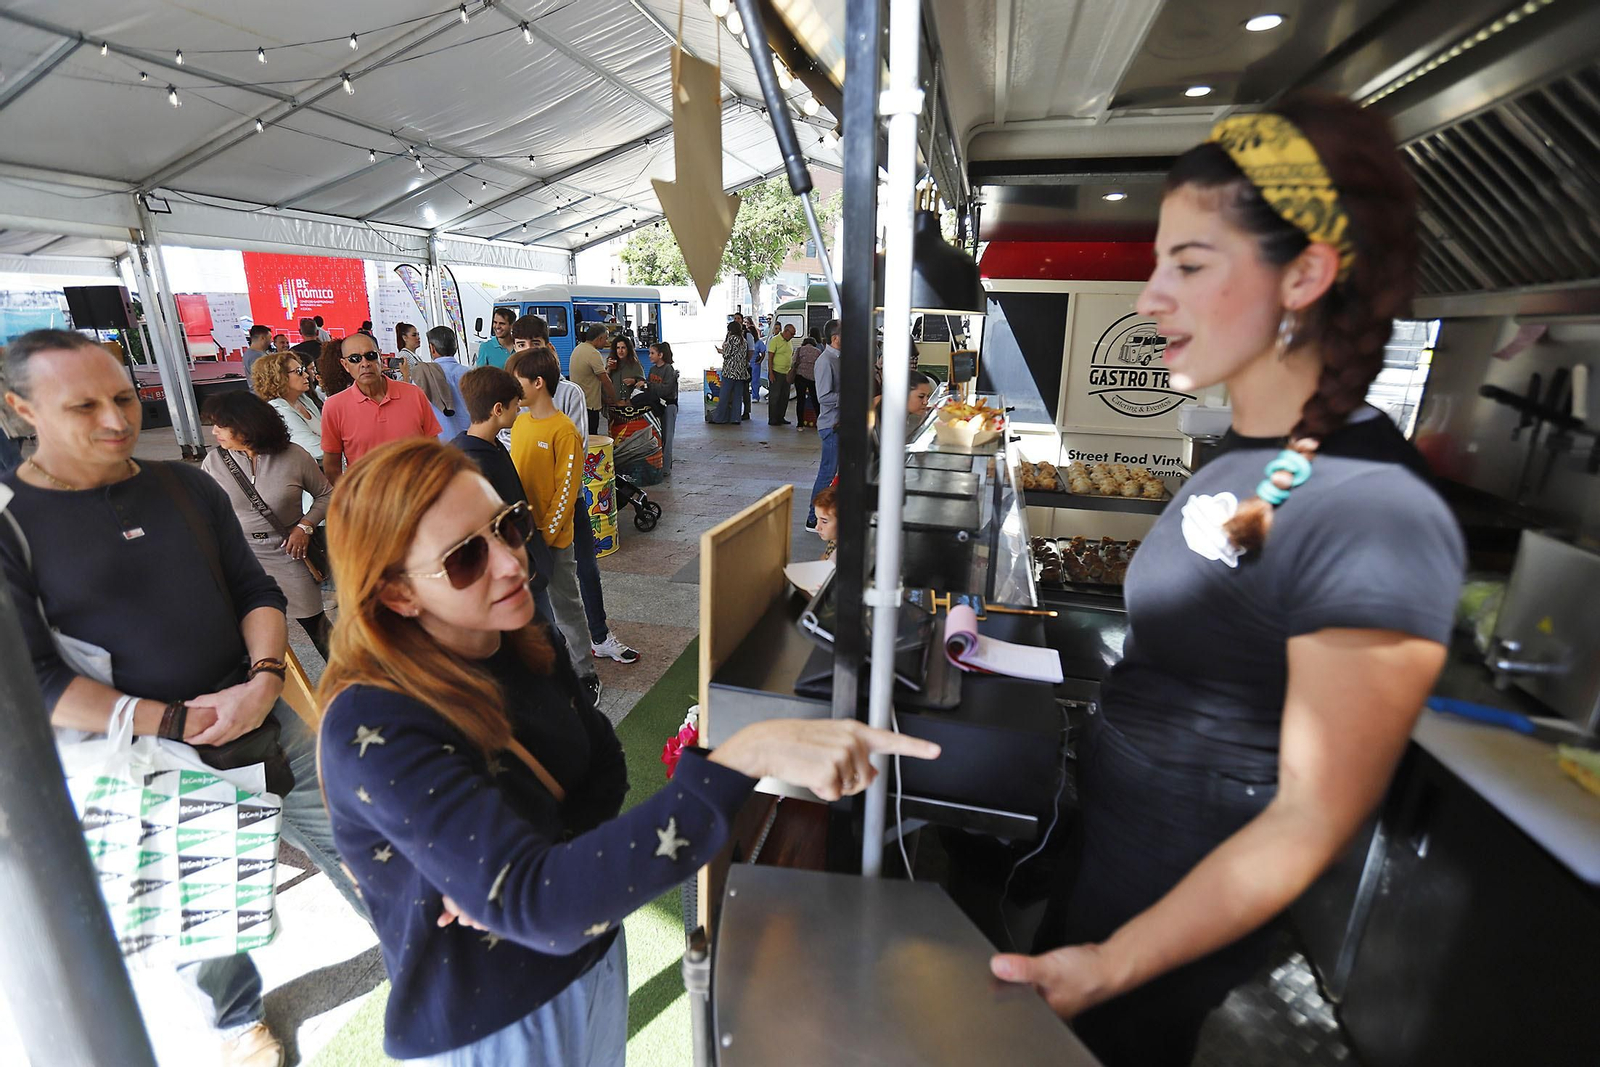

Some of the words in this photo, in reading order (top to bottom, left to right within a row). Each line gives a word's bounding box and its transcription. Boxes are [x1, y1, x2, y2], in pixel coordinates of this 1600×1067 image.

[1089, 369, 1148, 387] GASTRO
[1152, 371, 1171, 388] TR
[1111, 396, 1138, 413] Catering
[1146, 399, 1172, 412] Eventos
[1068, 449, 1109, 462] Street
[1114, 452, 1148, 465] Food
[1152, 455, 1183, 467] Vint
[1146, 468, 1182, 478] Evento
